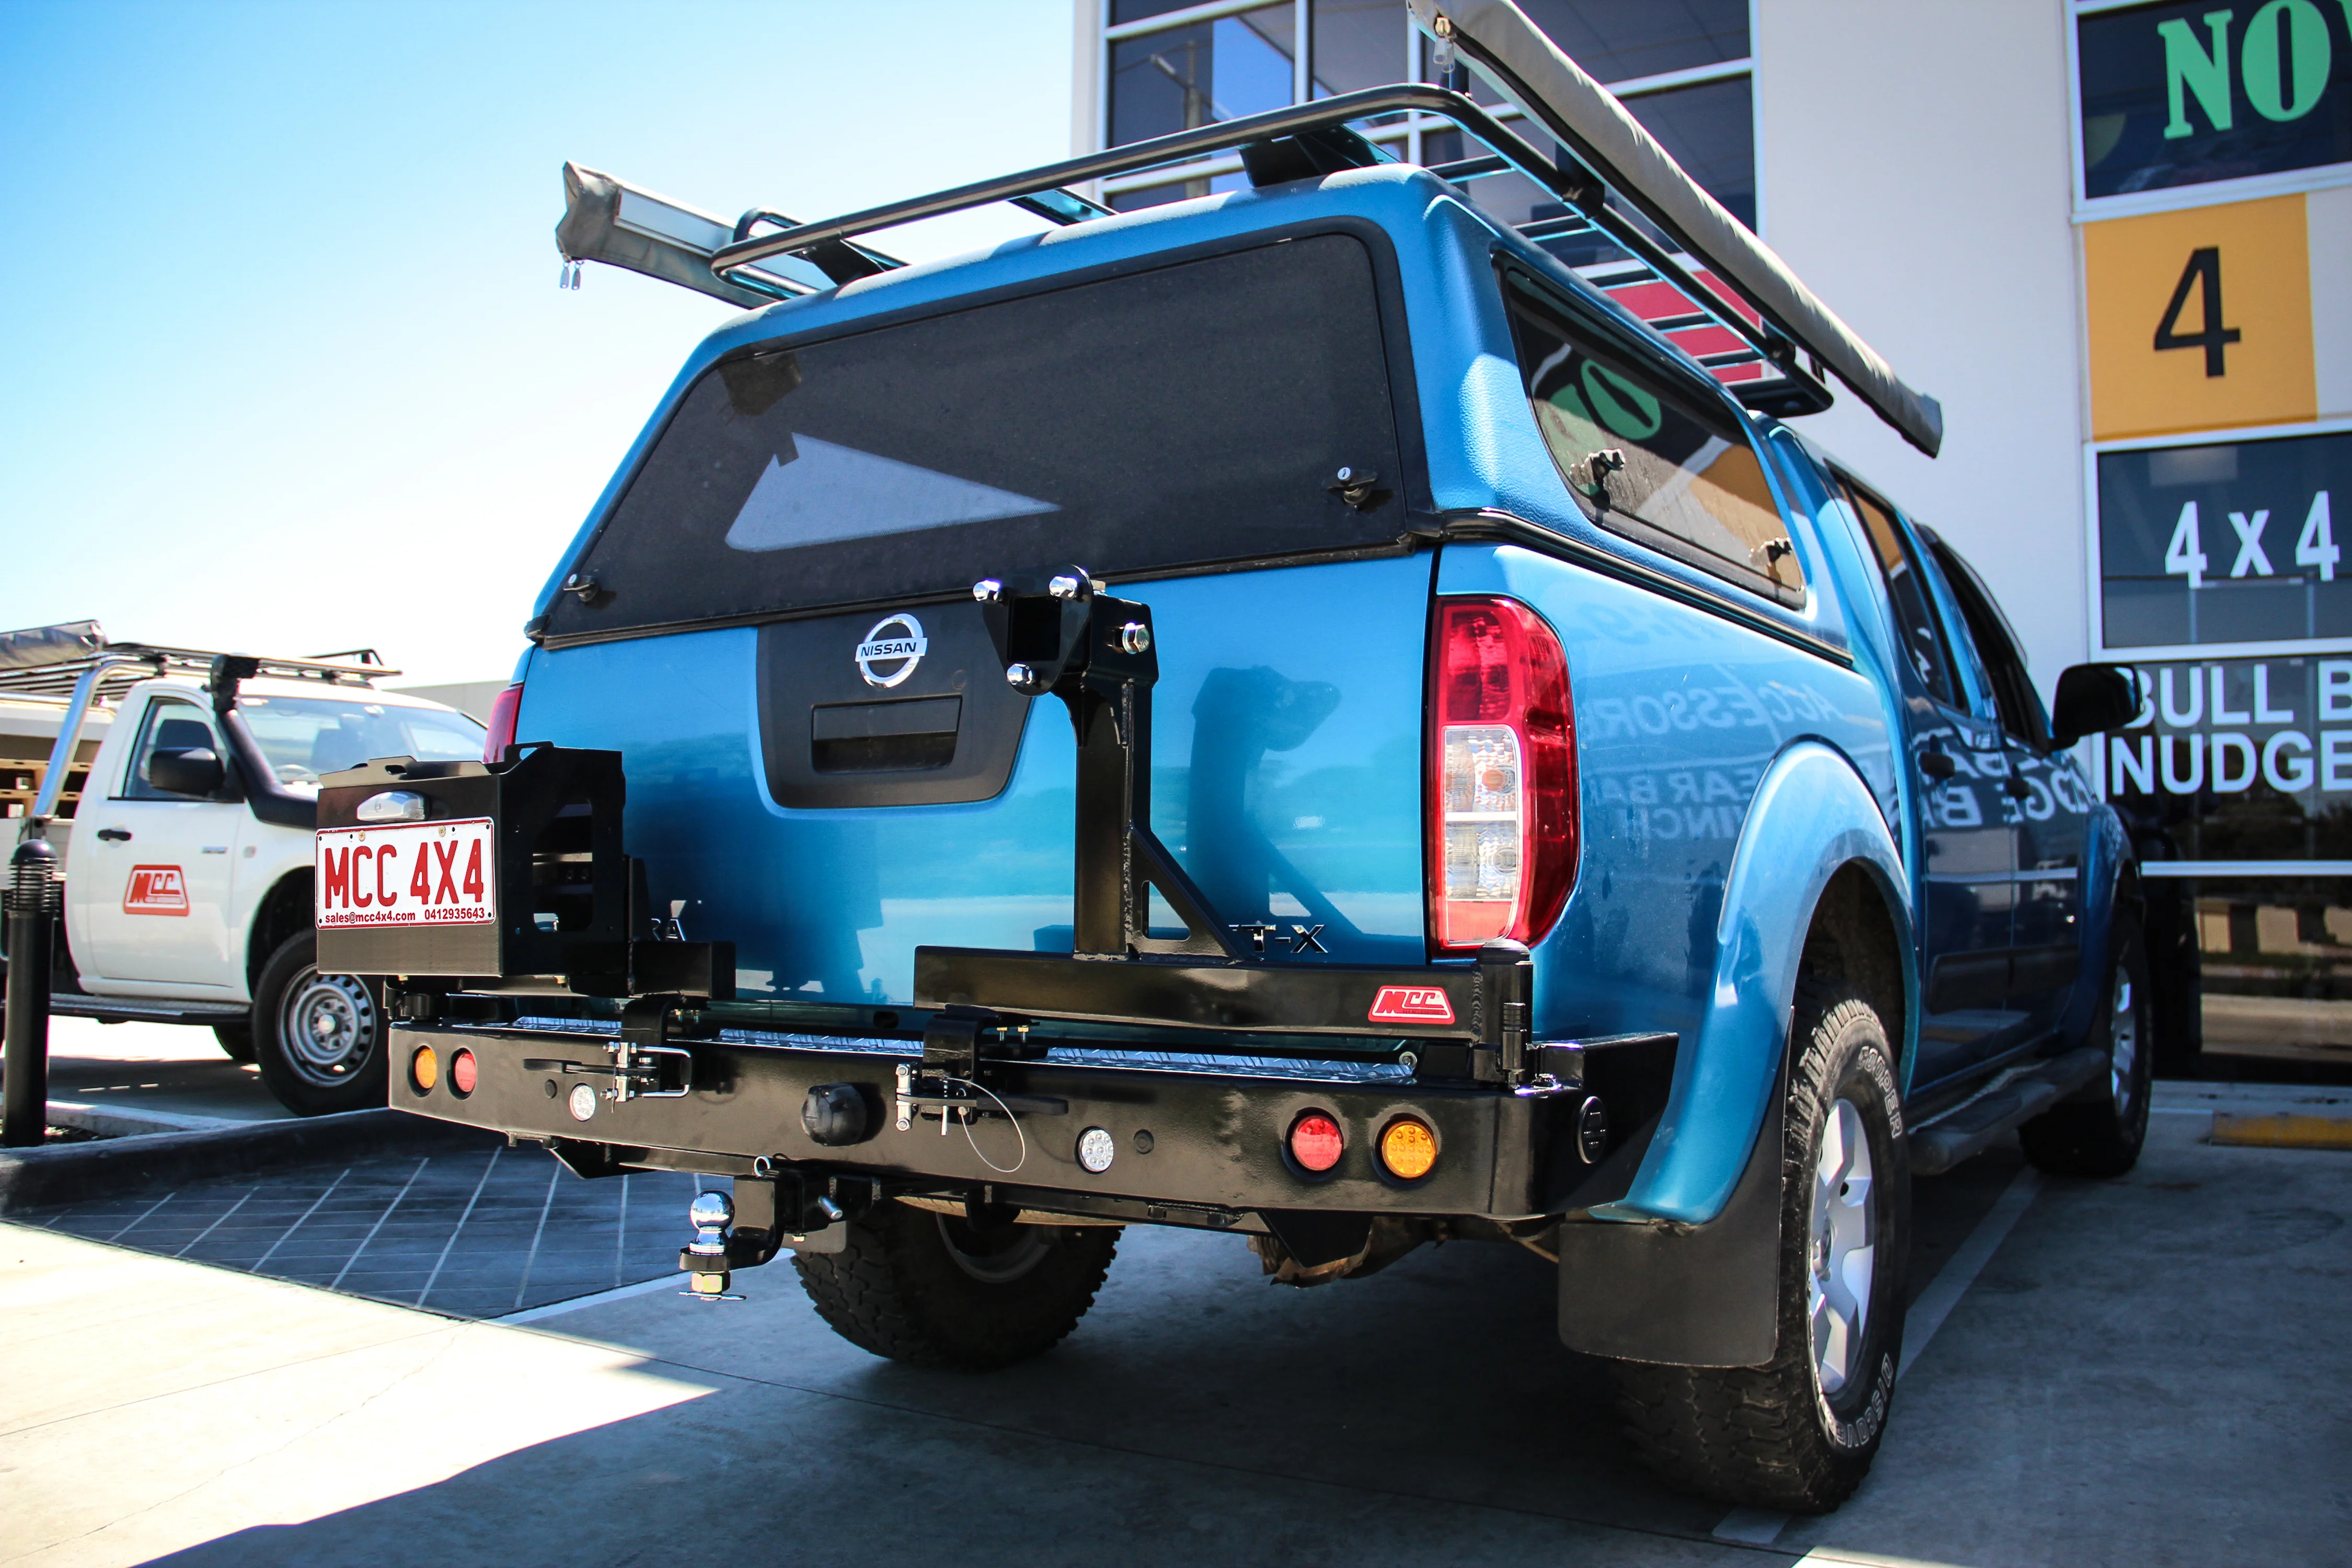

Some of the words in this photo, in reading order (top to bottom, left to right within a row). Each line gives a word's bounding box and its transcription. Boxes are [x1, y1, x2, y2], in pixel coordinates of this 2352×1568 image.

[2157, 0, 2352, 140] NO
[2153, 246, 2241, 378] 4
[861, 642, 917, 657] NISSAN
[2111, 730, 2352, 796] NUDGE
[129, 873, 181, 903] MCC
[325, 844, 397, 909] MCC
[410, 839, 484, 905] 4X4
[325, 911, 416, 924] sales@mcc4x4.com
[424, 907, 485, 920] 0412935643
[1228, 924, 1329, 953] T-X
[1375, 991, 1445, 1013] MCC
